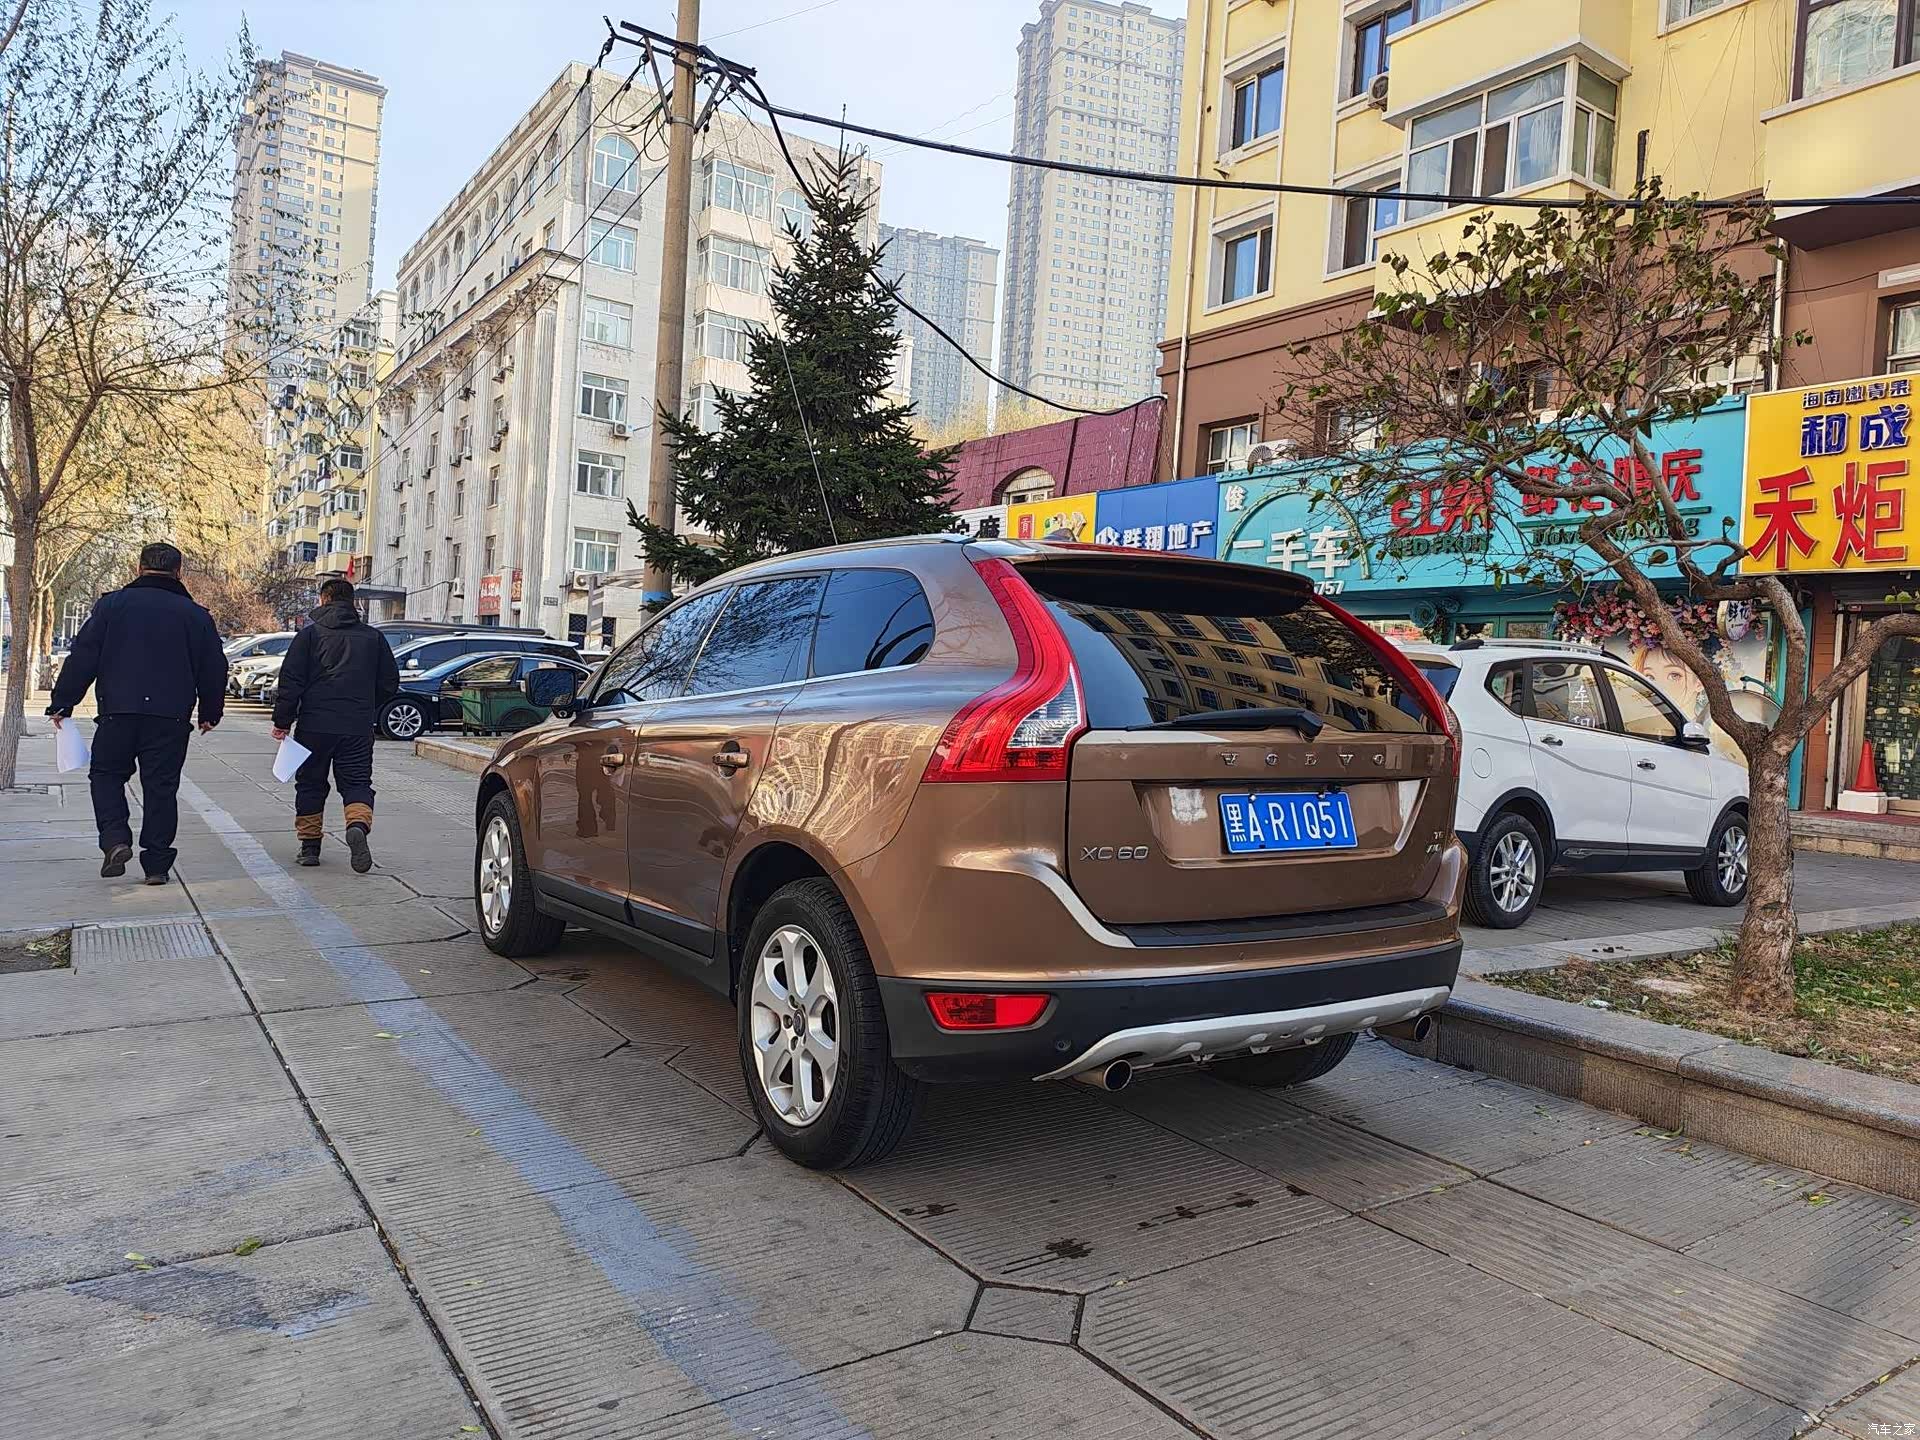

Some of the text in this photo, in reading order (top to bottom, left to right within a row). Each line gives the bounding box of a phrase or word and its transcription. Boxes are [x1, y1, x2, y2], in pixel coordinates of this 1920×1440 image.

[1800, 403, 1910, 458] 和成
[1748, 459, 1909, 570] 禾炬
[1220, 752, 1386, 766] VOLVO
[1080, 846, 1149, 861] XC60
